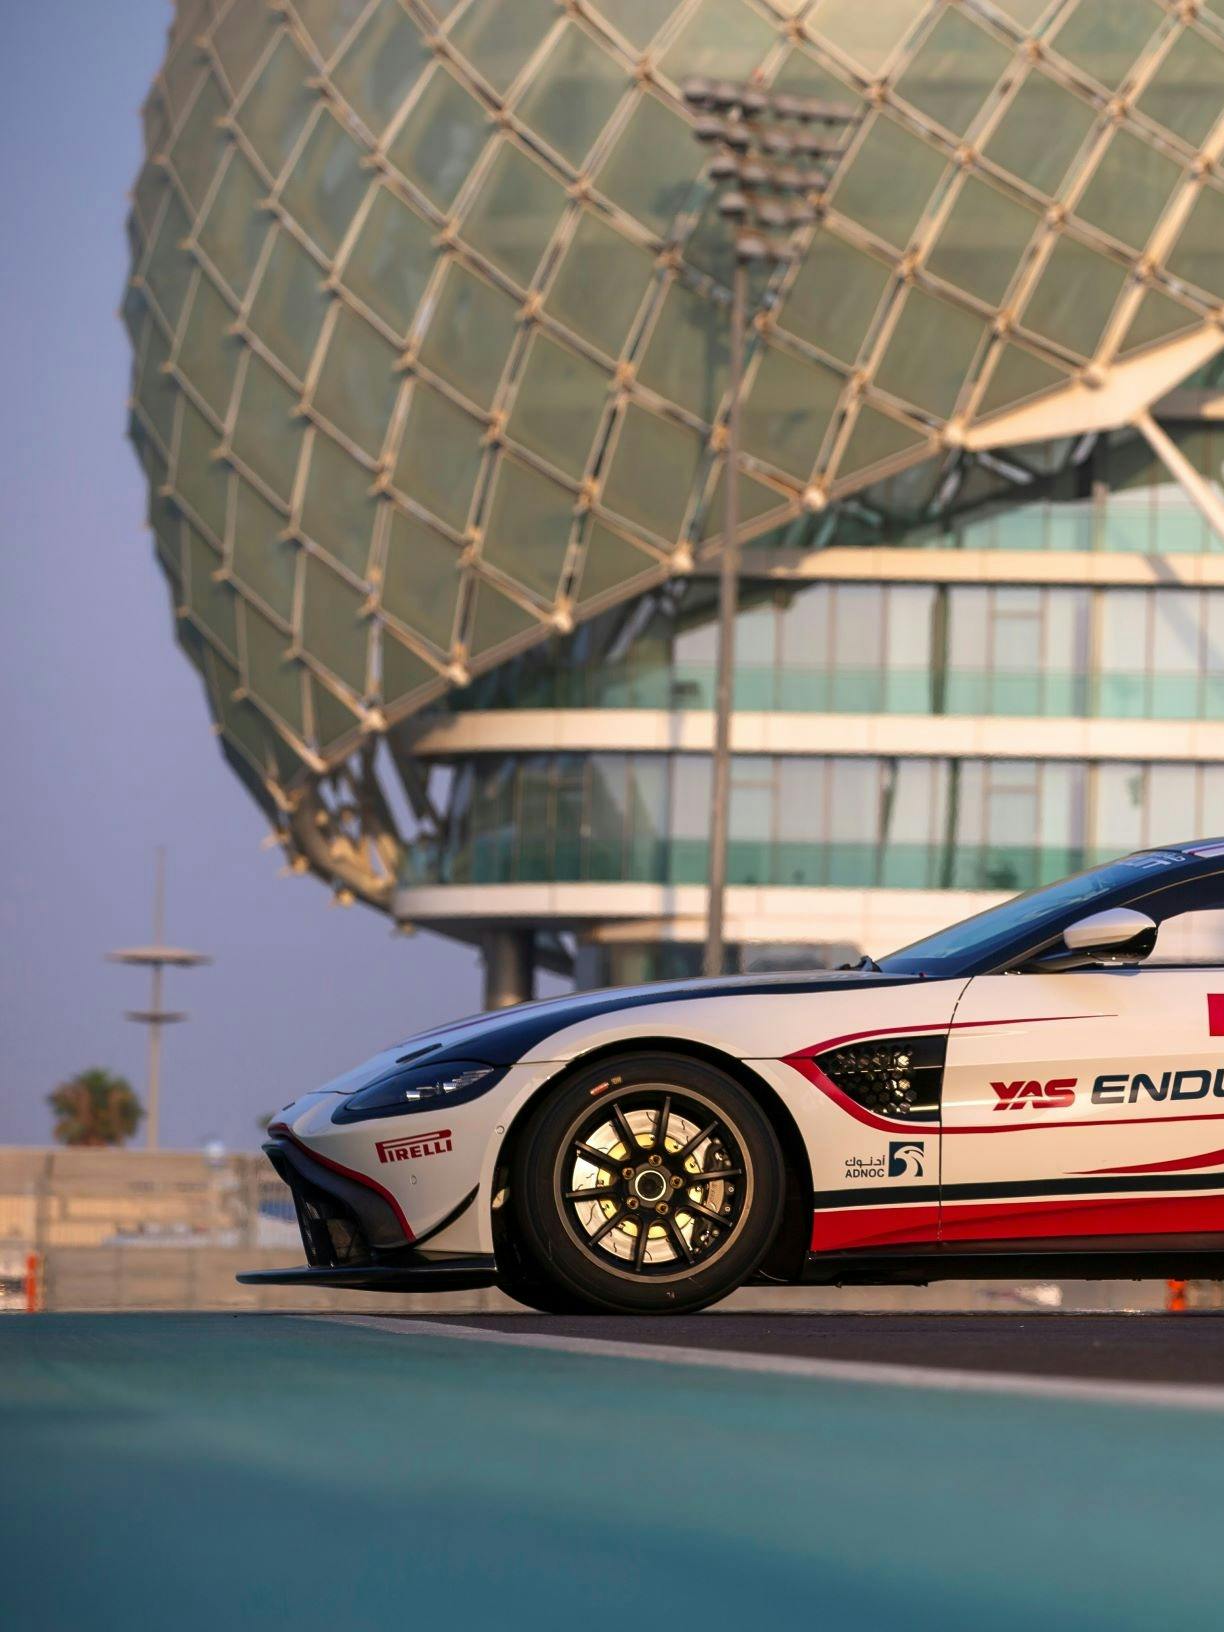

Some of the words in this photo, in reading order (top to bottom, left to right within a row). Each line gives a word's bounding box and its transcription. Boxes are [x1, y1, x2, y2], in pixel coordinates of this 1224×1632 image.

[990, 1078, 1078, 1111] YAS
[375, 1129, 453, 1163] PIRELLI
[845, 1169, 885, 1178] ADNOC
